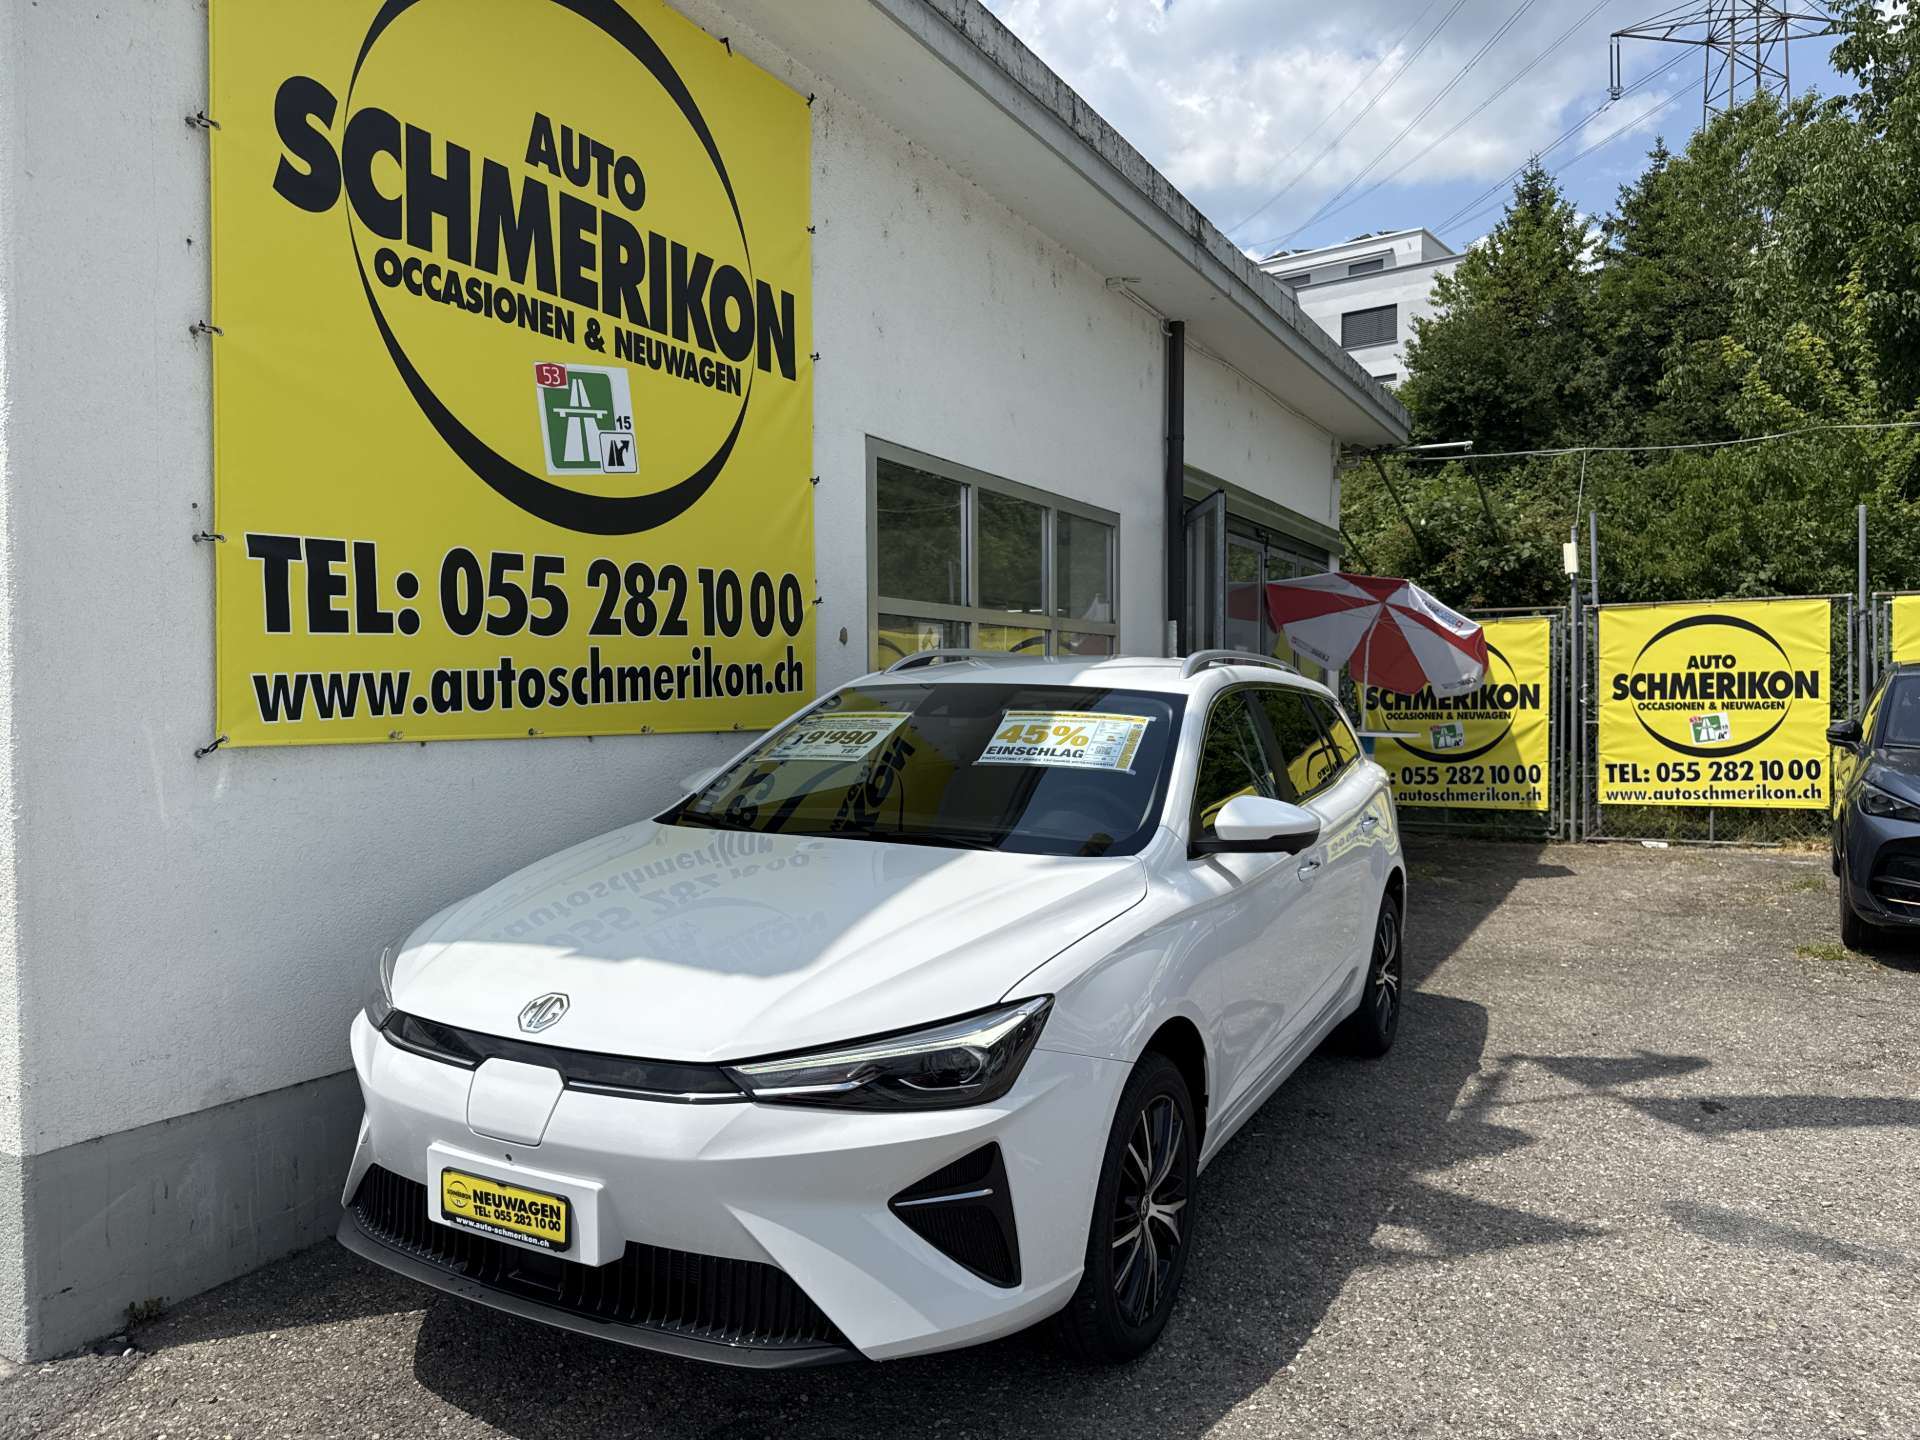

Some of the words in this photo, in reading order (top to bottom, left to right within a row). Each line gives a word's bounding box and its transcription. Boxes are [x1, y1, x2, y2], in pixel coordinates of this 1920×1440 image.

[525, 111, 646, 211] AUTO
[272, 75, 796, 381] SCHMERIKON
[374, 247, 575, 344] OCCASIONEN
[583, 317, 605, 353] &
[614, 326, 742, 397] NEUWAGEN
[542, 366, 561, 385] 53
[616, 416, 632, 430] 15
[245, 531, 420, 636] TEL:
[440, 546, 569, 638] 055
[587, 558, 689, 638] 282
[1687, 654, 1736, 670] AUTO
[252, 646, 804, 724] www.autoschmerikon.ch
[1612, 670, 1819, 700] SCHMERIKON
[1386, 712, 1443, 720] OCCASIONEN
[1447, 711, 1453, 720] &
[1457, 711, 1511, 720] NEUWAGEN
[1638, 701, 1704, 711] OCCASIONEN
[1709, 702, 1717, 711] &
[1721, 701, 1785, 711] NEUWAGEN
[986, 746, 1084, 758] EINSCHLAG
[1401, 766, 1439, 785] 055
[1445, 765, 1484, 785] 282
[1605, 763, 1650, 783] TEL:
[1656, 761, 1700, 783] 055
[1708, 760, 1754, 782] 282
[1606, 784, 1821, 801] www.autoschmerikon.ch
[521, 995, 566, 1030] MG
[473, 1189, 561, 1220] NEUWAGEN
[473, 1205, 491, 1218] TEL:
[494, 1209, 512, 1222] 055
[514, 1213, 532, 1226] 282
